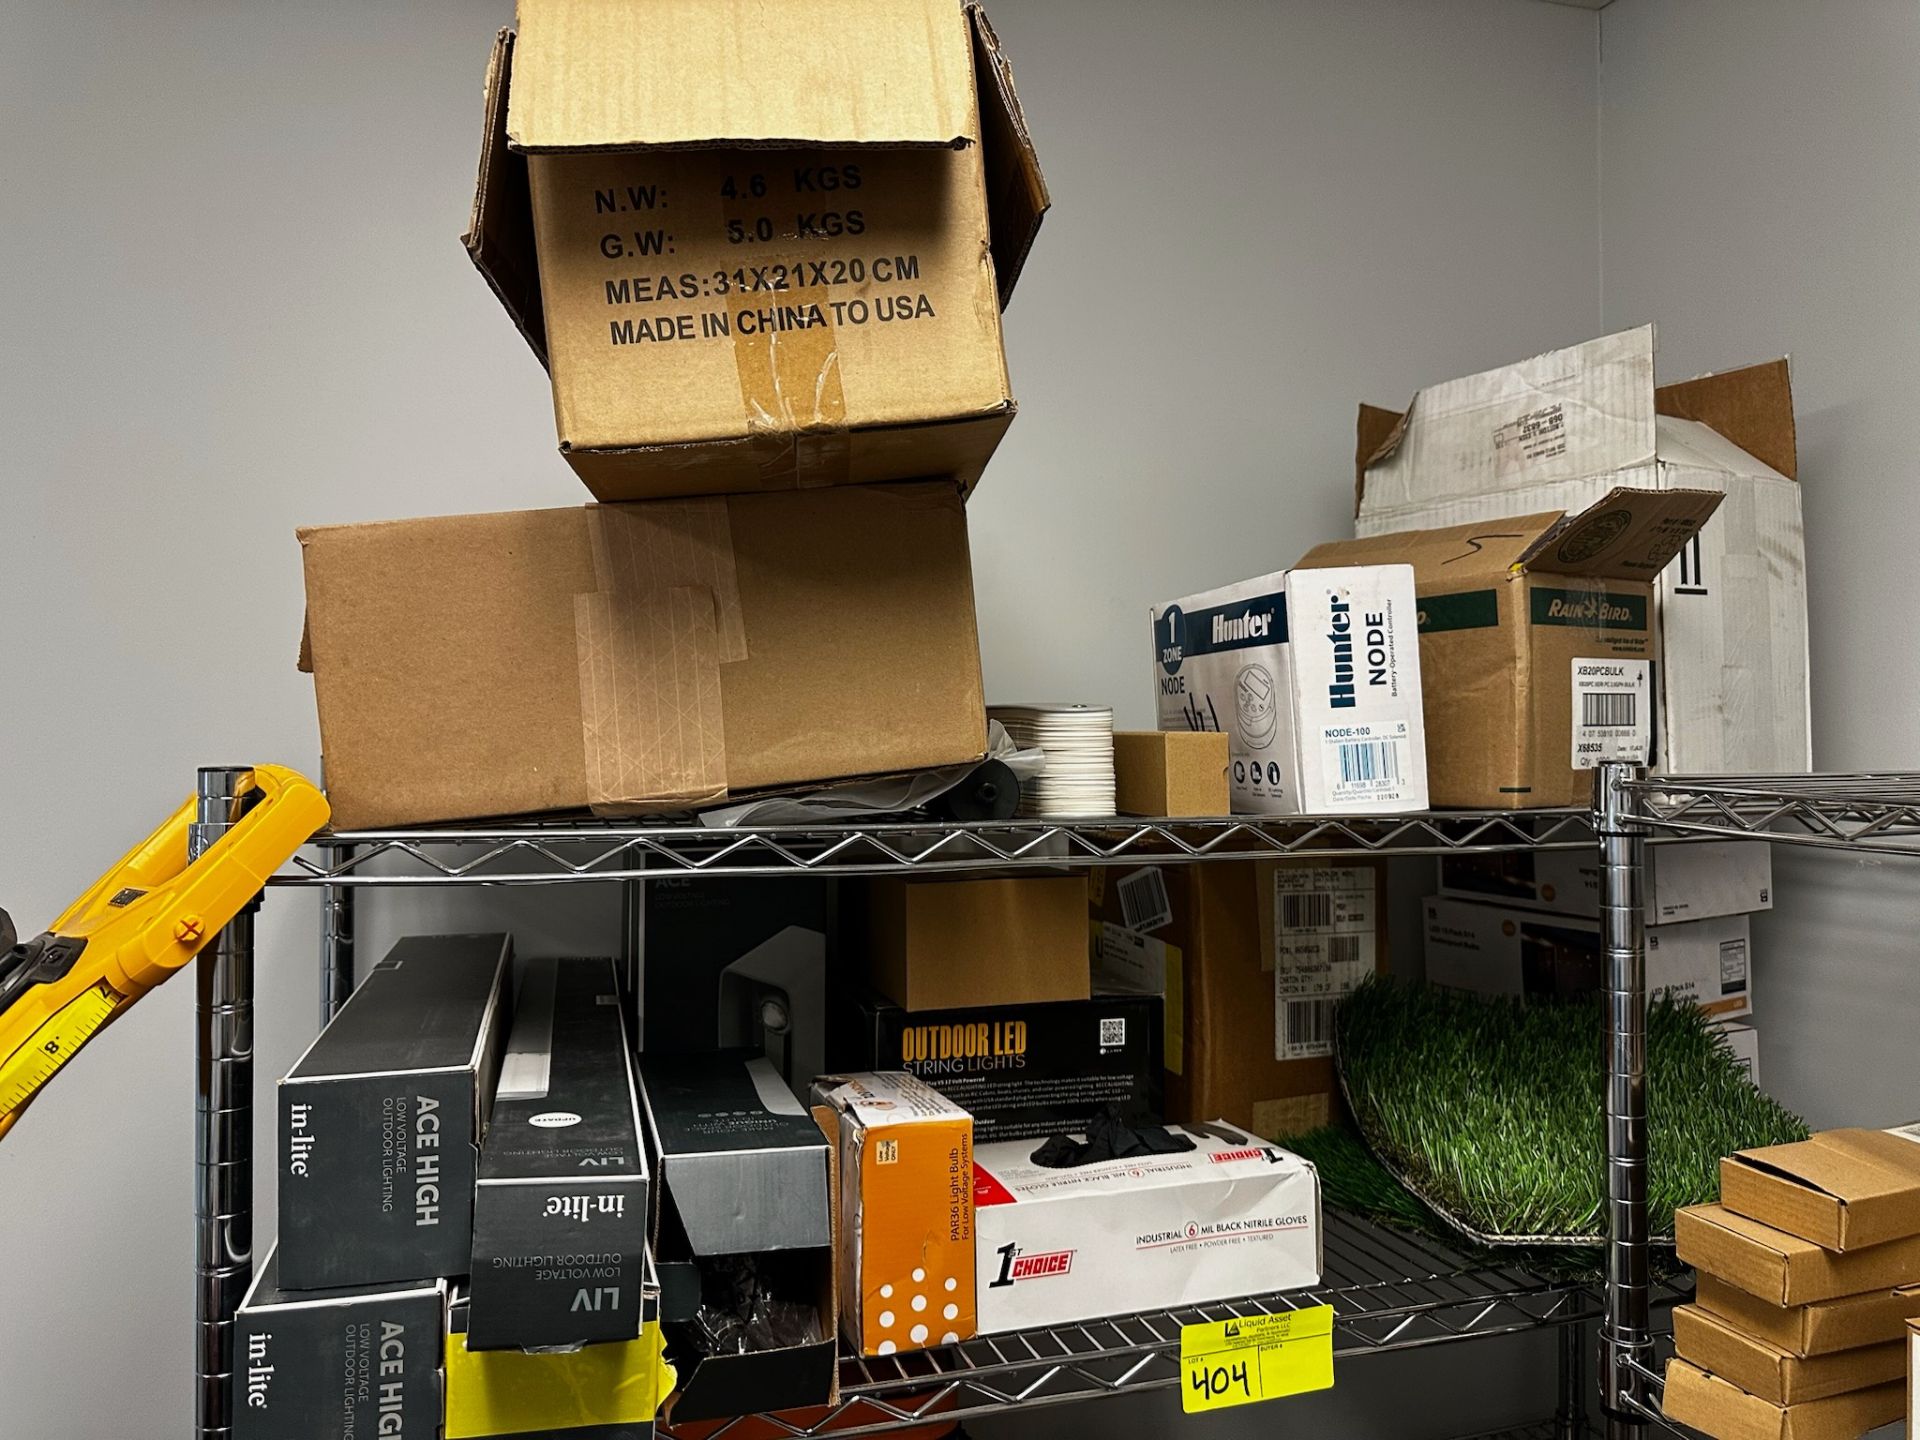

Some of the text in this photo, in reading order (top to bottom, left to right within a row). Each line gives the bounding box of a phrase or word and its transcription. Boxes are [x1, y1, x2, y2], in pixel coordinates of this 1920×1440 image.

[594, 164, 862, 214] N.W: 4.6 KGS
[600, 210, 866, 259] G.W: 5.0 KGS
[871, 255, 921, 283] CM
[611, 294, 936, 346] MADE IN CHINA TO USA
[1548, 598, 1630, 621] RAIN BIRD
[1168, 611, 1176, 644] 1
[1212, 609, 1272, 645] Hunter
[1162, 646, 1183, 664] ZONE
[1326, 594, 1357, 709] Hunter
[1365, 612, 1388, 686] NODE
[1386, 599, 1398, 698] Battery-Operated Controller
[1161, 676, 1186, 696] NODE
[1578, 666, 1624, 677] XB20PCBULK
[1325, 727, 1371, 738] NODE-100
[44, 1040, 59, 1055] 8
[902, 1020, 1027, 1062] OUTDOOR LED
[902, 1055, 1026, 1075] STRING LIGHTS
[290, 1103, 316, 1177] in-lite
[396, 1096, 407, 1174] LOW VOLTAGE
[382, 1097, 394, 1213] OUTDOOR LIGHTING
[415, 1095, 441, 1227] ACE HIGH
[578, 1156, 625, 1167] LIV
[949, 1148, 961, 1241] PAR36 Light Bulb
[960, 1134, 970, 1241] For Low Voltage Systems
[543, 1194, 625, 1223] in-lite
[1136, 1215, 1307, 1245] INDUSTRIAL 6 MIL BLACK NITRILE GLOVES
[1170, 1233, 1274, 1254] LATEX FREE POWDER FREE TEXTURED
[493, 1252, 622, 1270] OUTDOOR LIGHTING
[536, 1266, 621, 1281] LOW VOLTAGE
[1012, 1253, 1069, 1278] CHOICE
[570, 1286, 621, 1313] LIV
[1238, 1313, 1291, 1329] Liquid Asset
[345, 1324, 357, 1386] OUTDOOR
[358, 1322, 371, 1403] LOW VOLTAGE
[379, 1320, 406, 1377] ACE
[1188, 1357, 1199, 1365] LOT
[1260, 1344, 1277, 1352] BUYER
[247, 1333, 275, 1406] in-lite
[1192, 1360, 1251, 1400] 404
